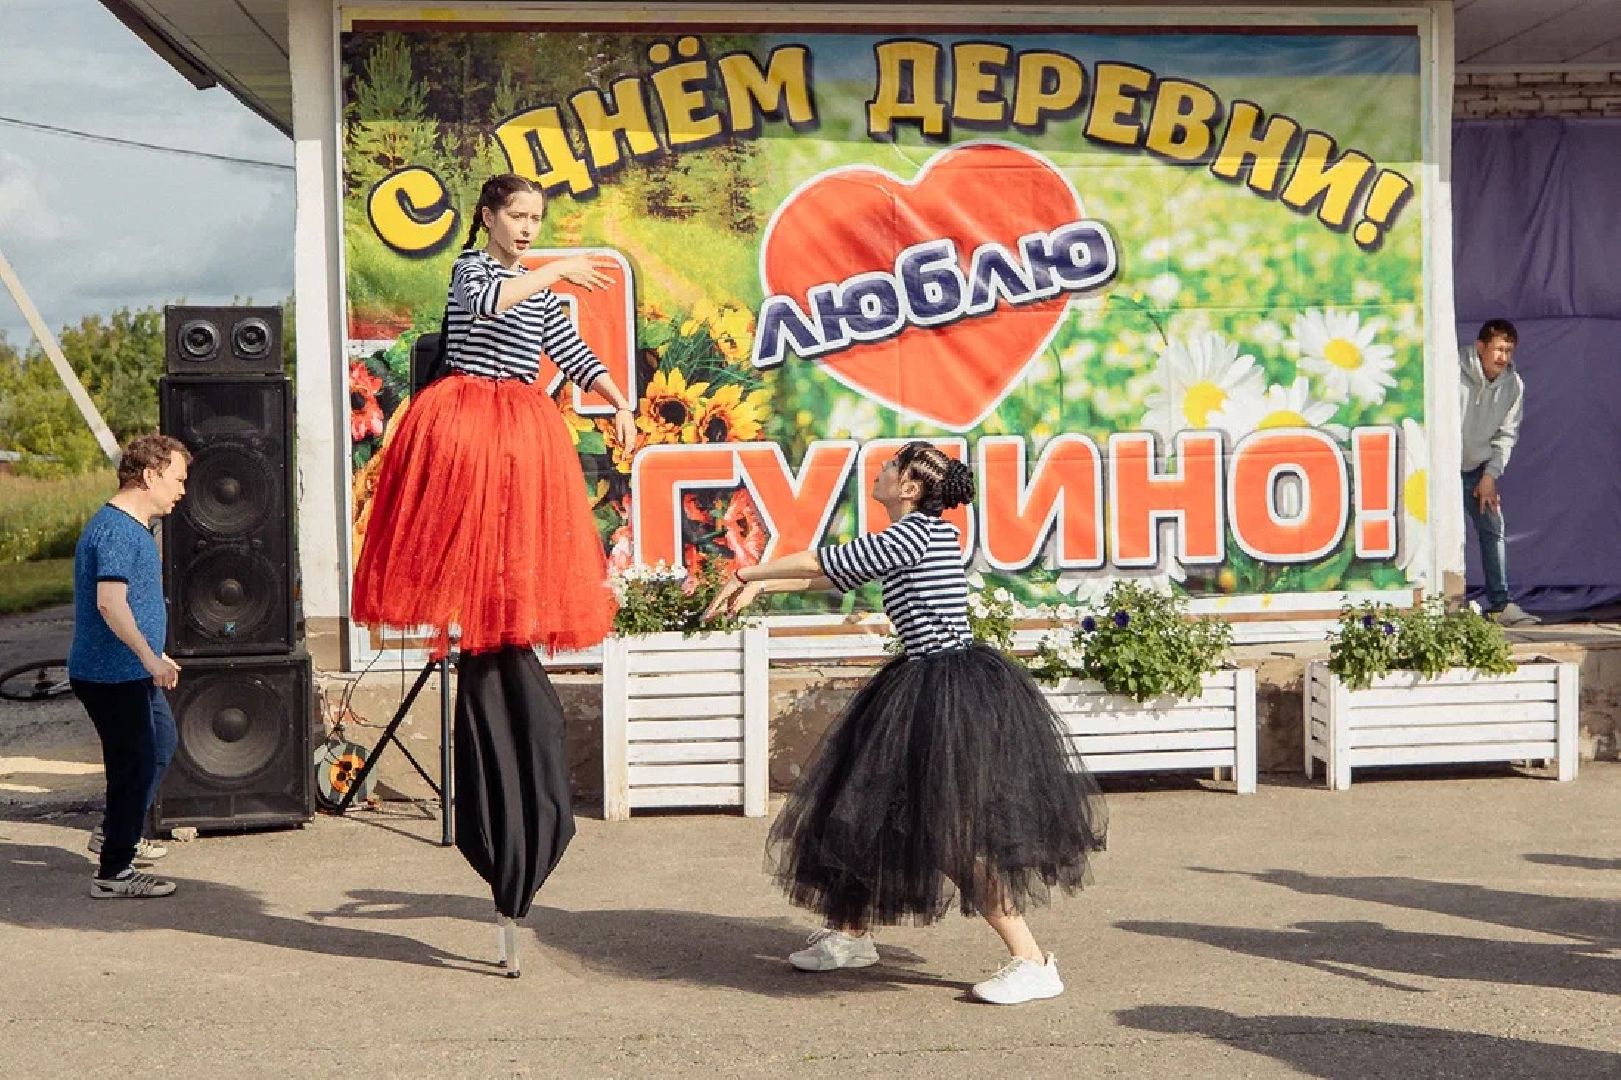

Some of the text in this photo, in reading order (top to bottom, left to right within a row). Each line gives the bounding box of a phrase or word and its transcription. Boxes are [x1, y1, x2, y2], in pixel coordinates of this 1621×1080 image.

[369, 37, 1413, 253] С ДНЁМ ДЕРЕВНИ!
